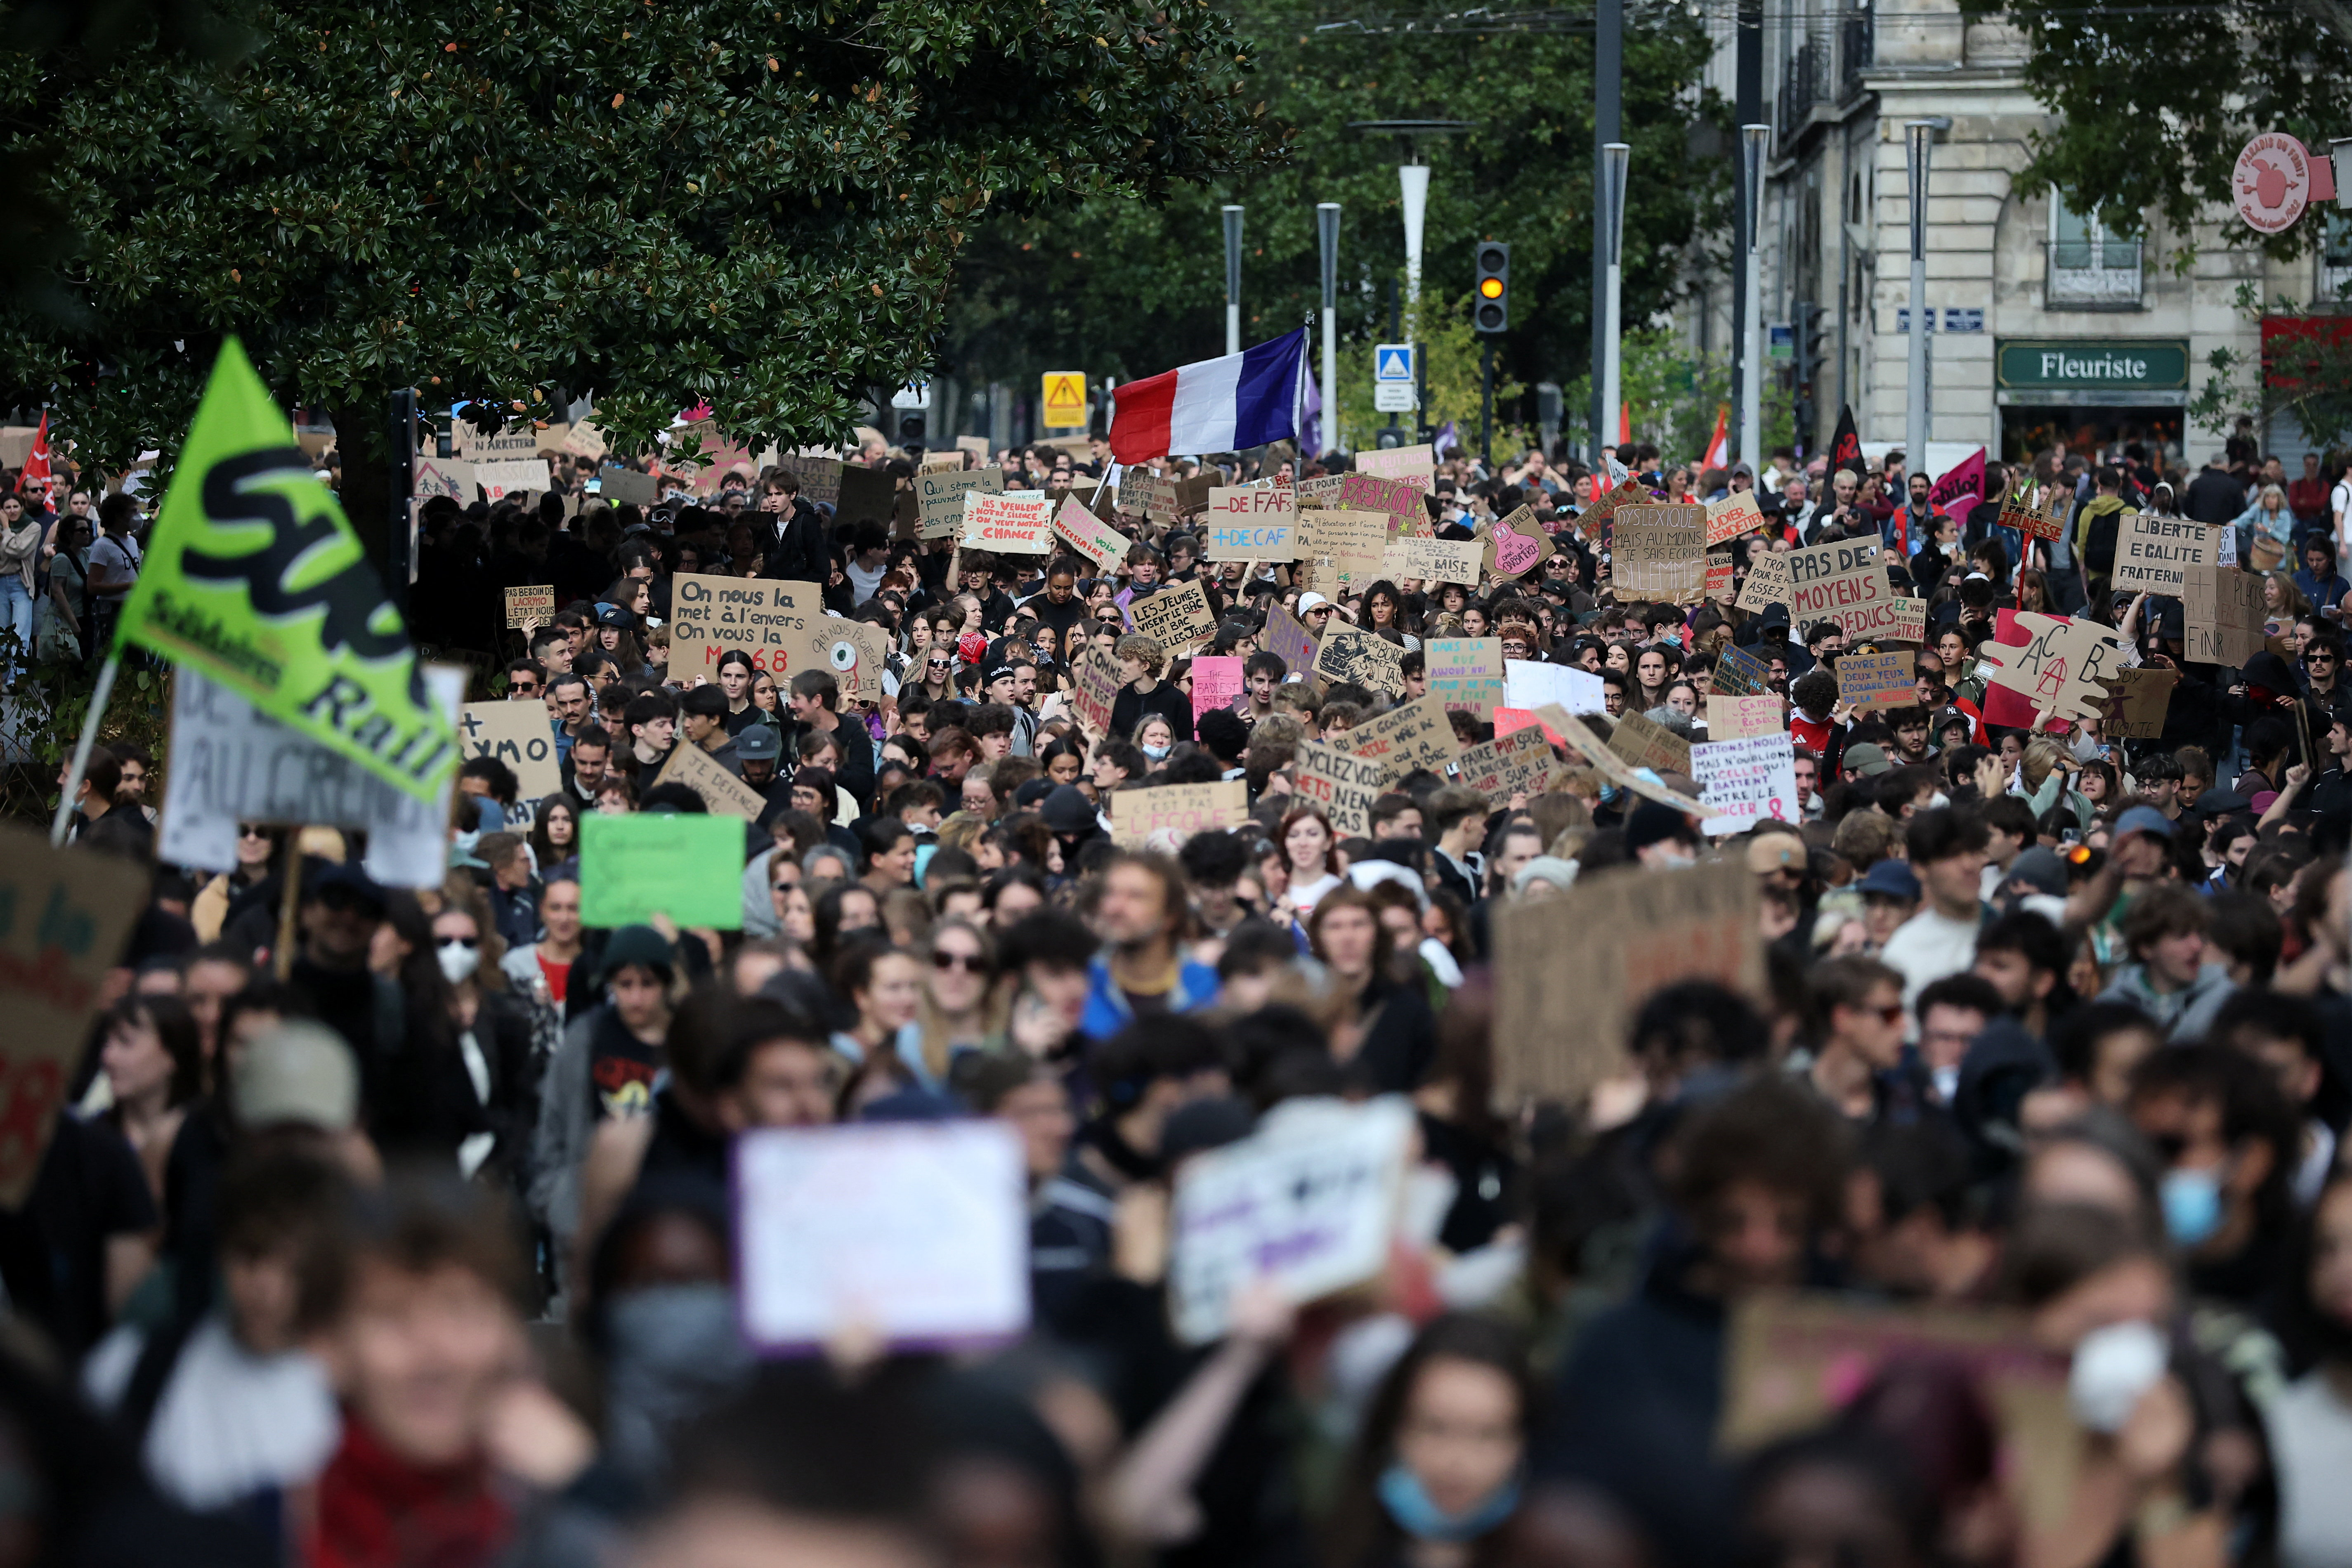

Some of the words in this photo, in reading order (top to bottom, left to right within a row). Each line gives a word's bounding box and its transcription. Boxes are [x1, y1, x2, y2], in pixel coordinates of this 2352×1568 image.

[2040, 352, 2147, 379] Fleuriste
[1359, 457, 1375, 470] ON
[1379, 455, 1401, 468] VEUT
[925, 480, 943, 495] Qui
[950, 482, 976, 492] sème
[982, 477, 991, 486] la
[977, 508, 1004, 517] NOTRE
[1001, 502, 1045, 512] VEULENT
[1709, 498, 1738, 516] VEUT
[925, 515, 940, 527] des
[2001, 512, 2062, 539] JEUNESSE
[983, 527, 1035, 540] CHANCE
[2135, 518, 2206, 541] LIBERTE
[1254, 528, 1287, 546] CAF
[1646, 532, 1662, 546] AU
[1502, 551, 1514, 561] DANS
[1624, 549, 1636, 562] JE
[1644, 548, 1665, 560] SAIS
[1435, 559, 1469, 573] BAISE
[1790, 552, 1832, 582] PAS
[1838, 545, 1871, 571] DE
[2137, 558, 2170, 569] sociale
[1753, 569, 1770, 580] POUR
[1773, 574, 1782, 583] SE
[2120, 566, 2183, 583] FRATERNI
[505, 588, 517, 597] PAS
[545, 587, 553, 595] DE
[1747, 581, 1784, 597] ASSEZ
[1795, 575, 1876, 612] MOYENS
[2145, 582, 2180, 592] peuples
[513, 597, 547, 606] LACRYMO
[681, 581, 711, 602] On
[720, 589, 764, 606] nous
[774, 588, 795, 608] la
[1745, 595, 1762, 606] POUR
[2234, 579, 2265, 612] PLACES
[508, 605, 533, 616] L'ÉTAT
[536, 607, 555, 615] NOUS
[1133, 605, 1157, 622] LES
[1159, 588, 1200, 612] JEUNES
[678, 605, 711, 620] met
[721, 605, 736, 623] à
[740, 608, 805, 630] l'envers
[1138, 613, 1170, 632] VISENT
[1171, 608, 1181, 619] LE
[1183, 598, 1204, 614] BAC
[675, 622, 704, 640] On
[713, 628, 755, 643] vous
[763, 627, 782, 645] la
[829, 623, 851, 635] NOUS
[1154, 626, 1167, 638] LA
[1172, 617, 1190, 631] BAC
[1169, 632, 1186, 646] LES
[1183, 621, 1218, 641] JEUNES
[1433, 641, 1461, 652] DANS
[1469, 641, 1483, 651] LA
[1086, 644, 1122, 684] COMME
[1378, 660, 1387, 668] ET
[1453, 656, 1476, 664] RUE
[1722, 652, 1733, 664] FAC
[1840, 659, 1875, 671] OUVRE
[1880, 656, 1896, 666] LES
[1209, 670, 1223, 680] THE
[1845, 672, 1872, 681] DEUX
[1877, 669, 1904, 680] YEUX
[1082, 678, 1092, 691] ON
[1094, 688, 1109, 705] EST
[1197, 683, 1238, 694] BADDEST
[1431, 680, 1459, 690] POUR
[1467, 680, 1478, 689] NE
[1484, 679, 1502, 688] PAS
[1750, 679, 1762, 690] BAC
[1844, 696, 1856, 704] DE
[1875, 690, 1913, 702] MERDE
[1742, 717, 1779, 727] REBELS
[1461, 746, 1493, 767] FAIRE
[1517, 730, 1543, 749] SOUS
[689, 754, 709, 776] JE
[1506, 765, 1532, 783] SUR
[1535, 758, 1548, 771] LE
[1354, 761, 1381, 788] VOS
[1464, 767, 1479, 782] LA
[1758, 787, 1777, 799] LE
[1327, 806, 1361, 832] PAS
